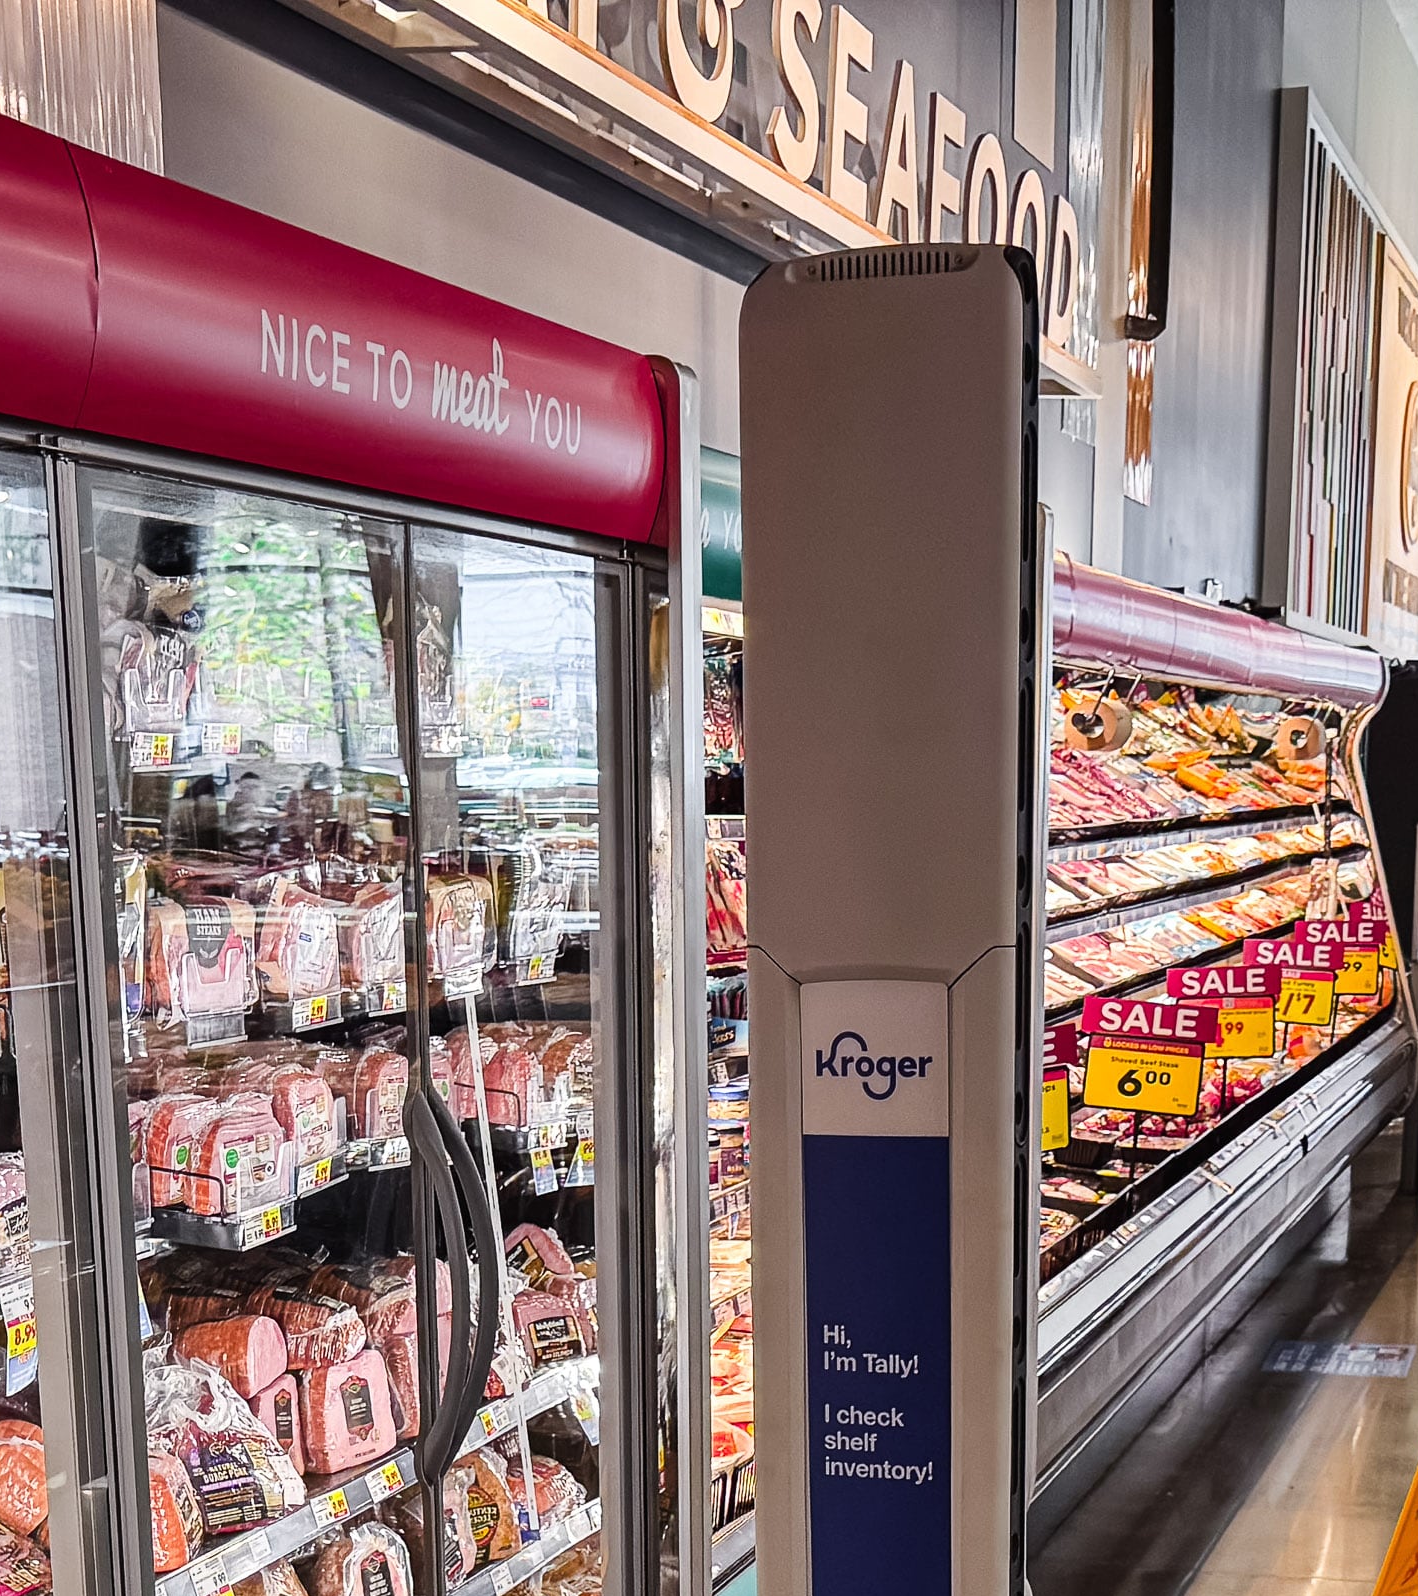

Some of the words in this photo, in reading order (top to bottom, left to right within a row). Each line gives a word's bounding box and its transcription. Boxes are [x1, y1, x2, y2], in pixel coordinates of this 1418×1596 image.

[765, 0, 1080, 351] SEAFOOD
[260, 308, 352, 395] NICE
[366, 341, 414, 409] TO
[431, 337, 510, 436] meat
[525, 389, 581, 455] YOU
[1306, 922, 1374, 943] SALE
[1256, 942, 1331, 967] SALE
[1181, 967, 1266, 996] SALE
[1098, 1001, 1198, 1039] SALE
[814, 1030, 934, 1101] Kroger
[1110, 1055, 1137, 1066] Shaved
[1138, 1056, 1157, 1067] Beef
[1158, 1058, 1179, 1069] Steak
[823, 1323, 853, 1349] Hi,
[823, 1349, 858, 1373] I'm
[862, 1353, 920, 1379] Tally!
[836, 1405, 905, 1428] check
[824, 1431, 878, 1453] shelf
[824, 1456, 935, 1484] inventory!
